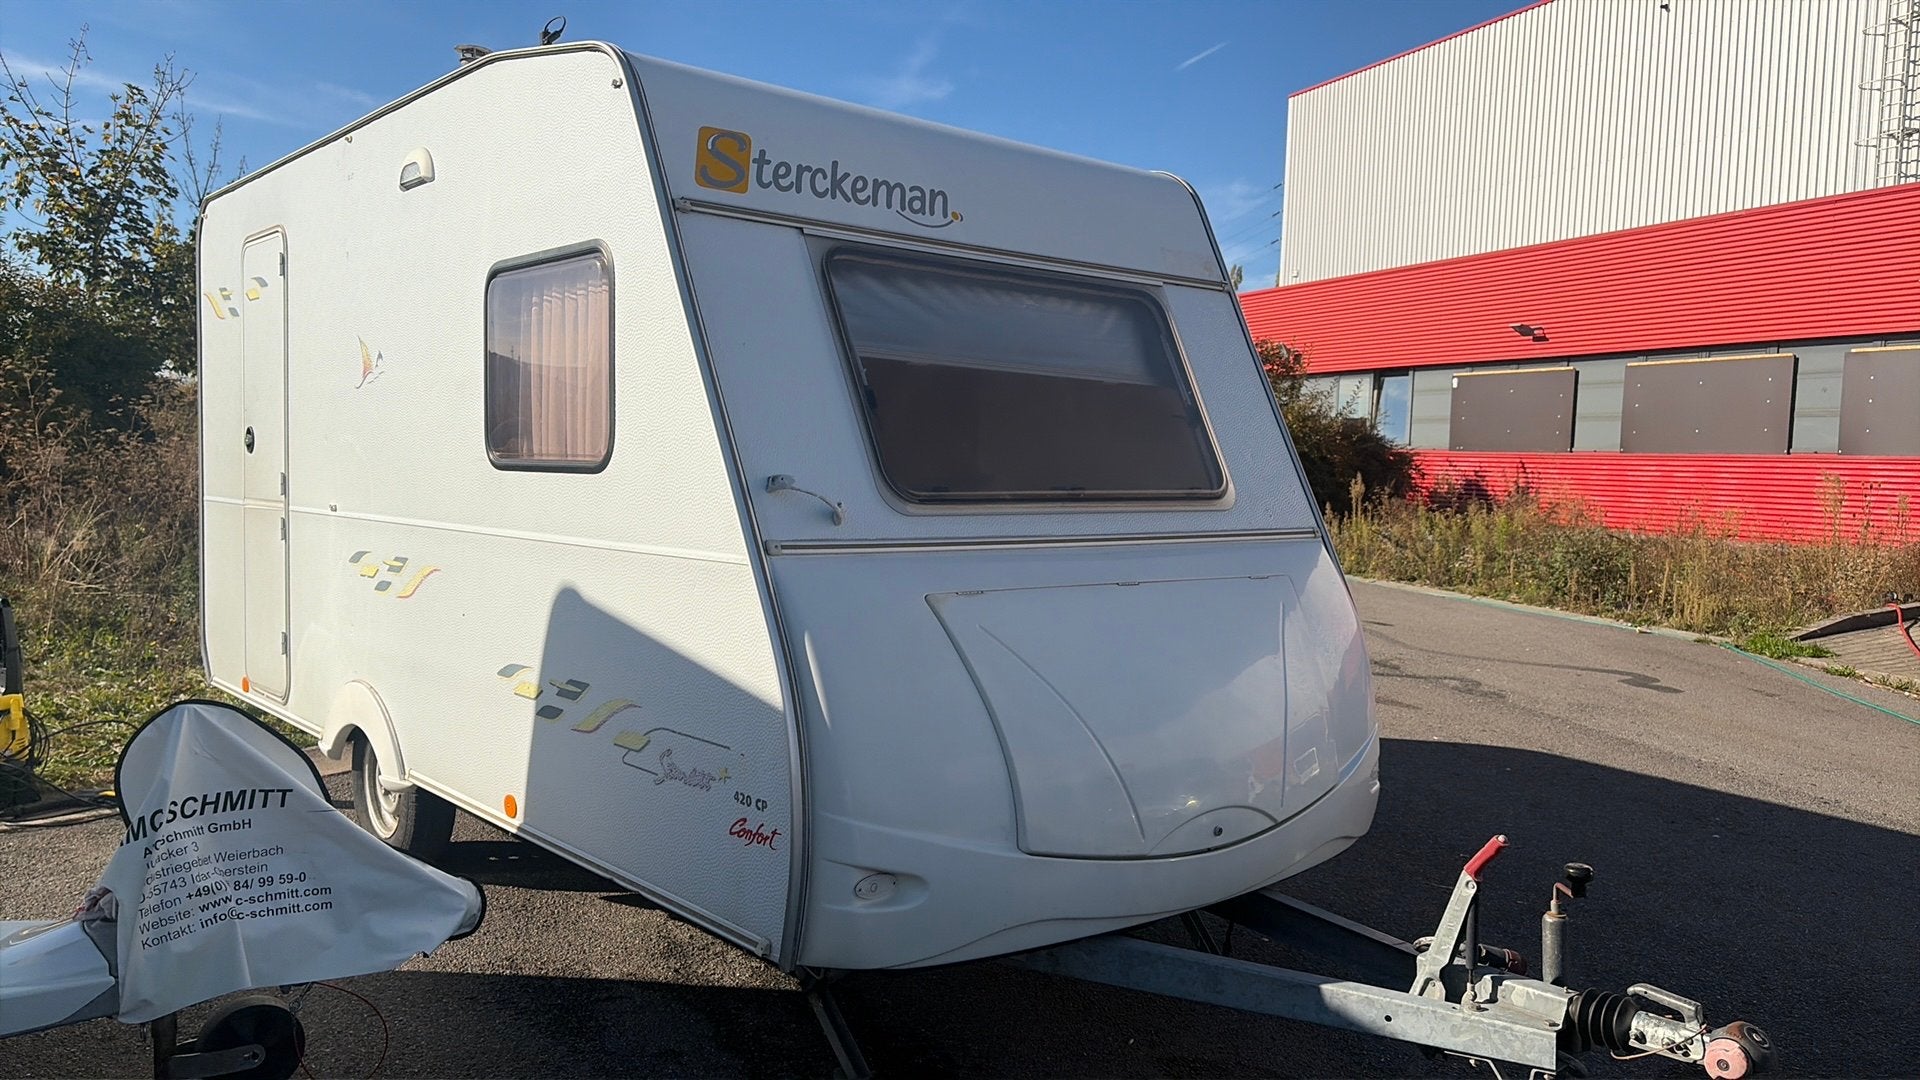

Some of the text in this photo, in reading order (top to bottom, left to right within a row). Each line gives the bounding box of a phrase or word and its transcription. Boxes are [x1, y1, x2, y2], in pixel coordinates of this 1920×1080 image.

[697, 129, 950, 220] Sterckeman
[733, 791, 769, 812] 420 CP
[207, 817, 252, 834] GmbH
[728, 817, 782, 851] Confort
[191, 841, 200, 852] 3
[213, 845, 284, 864] Weierbach
[138, 896, 181, 920] Telefon
[257, 875, 275, 888] 99
[278, 871, 307, 885] 59-0
[138, 908, 195, 935] Website:
[140, 923, 197, 951] Kontakt:
